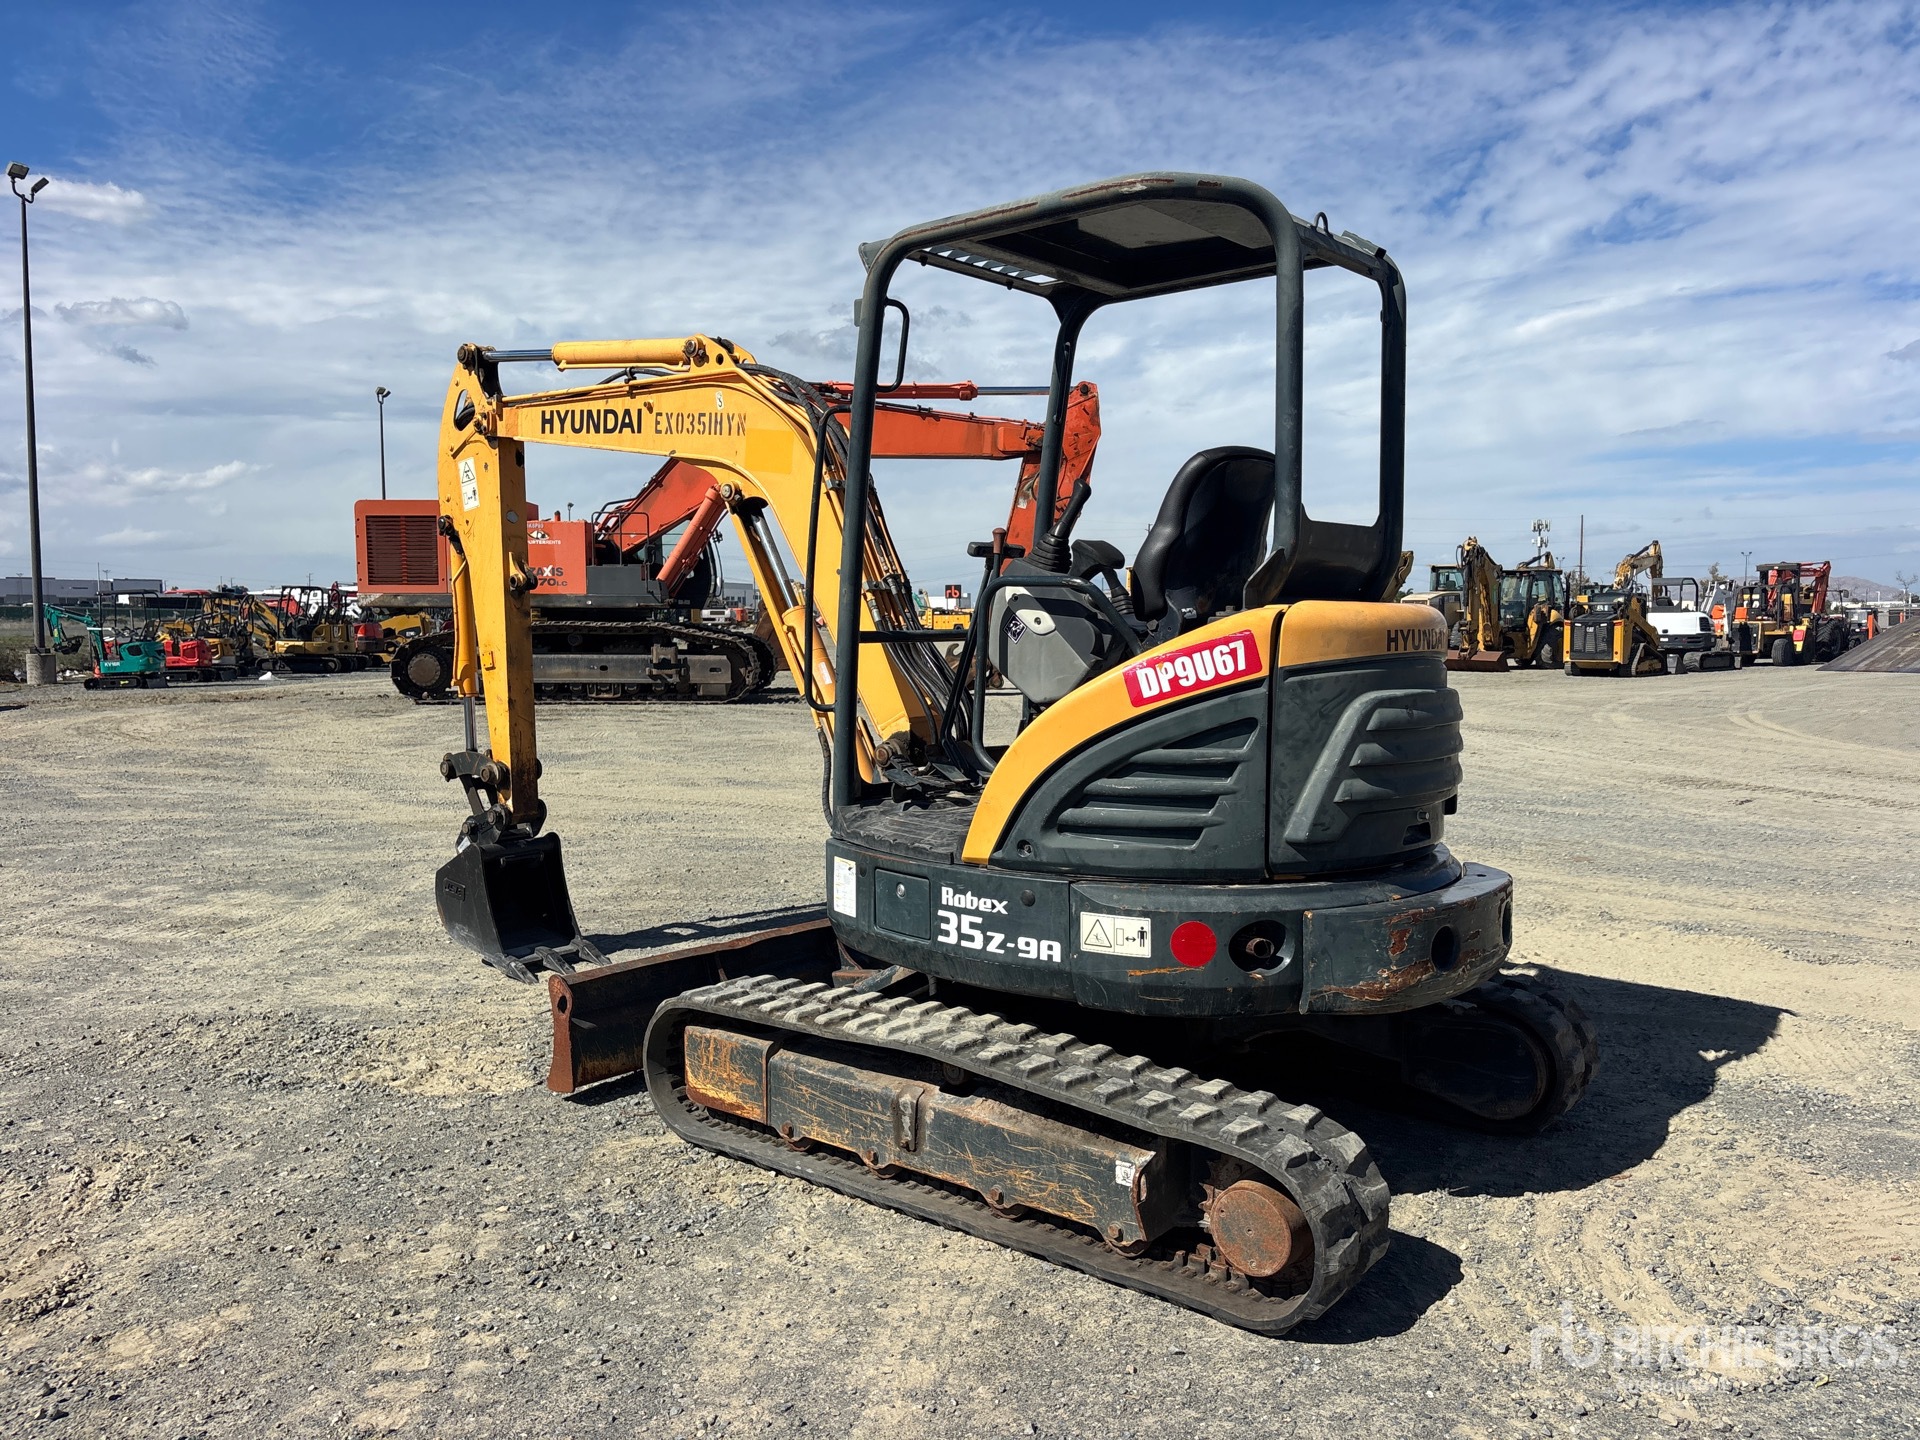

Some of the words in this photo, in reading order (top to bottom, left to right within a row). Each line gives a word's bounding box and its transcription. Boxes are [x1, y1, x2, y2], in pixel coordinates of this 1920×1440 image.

[541, 408, 642, 434] HYUNDAI
[946, 585, 960, 598] rb
[1136, 640, 1246, 699] DP9U67
[941, 886, 1009, 915] Robex
